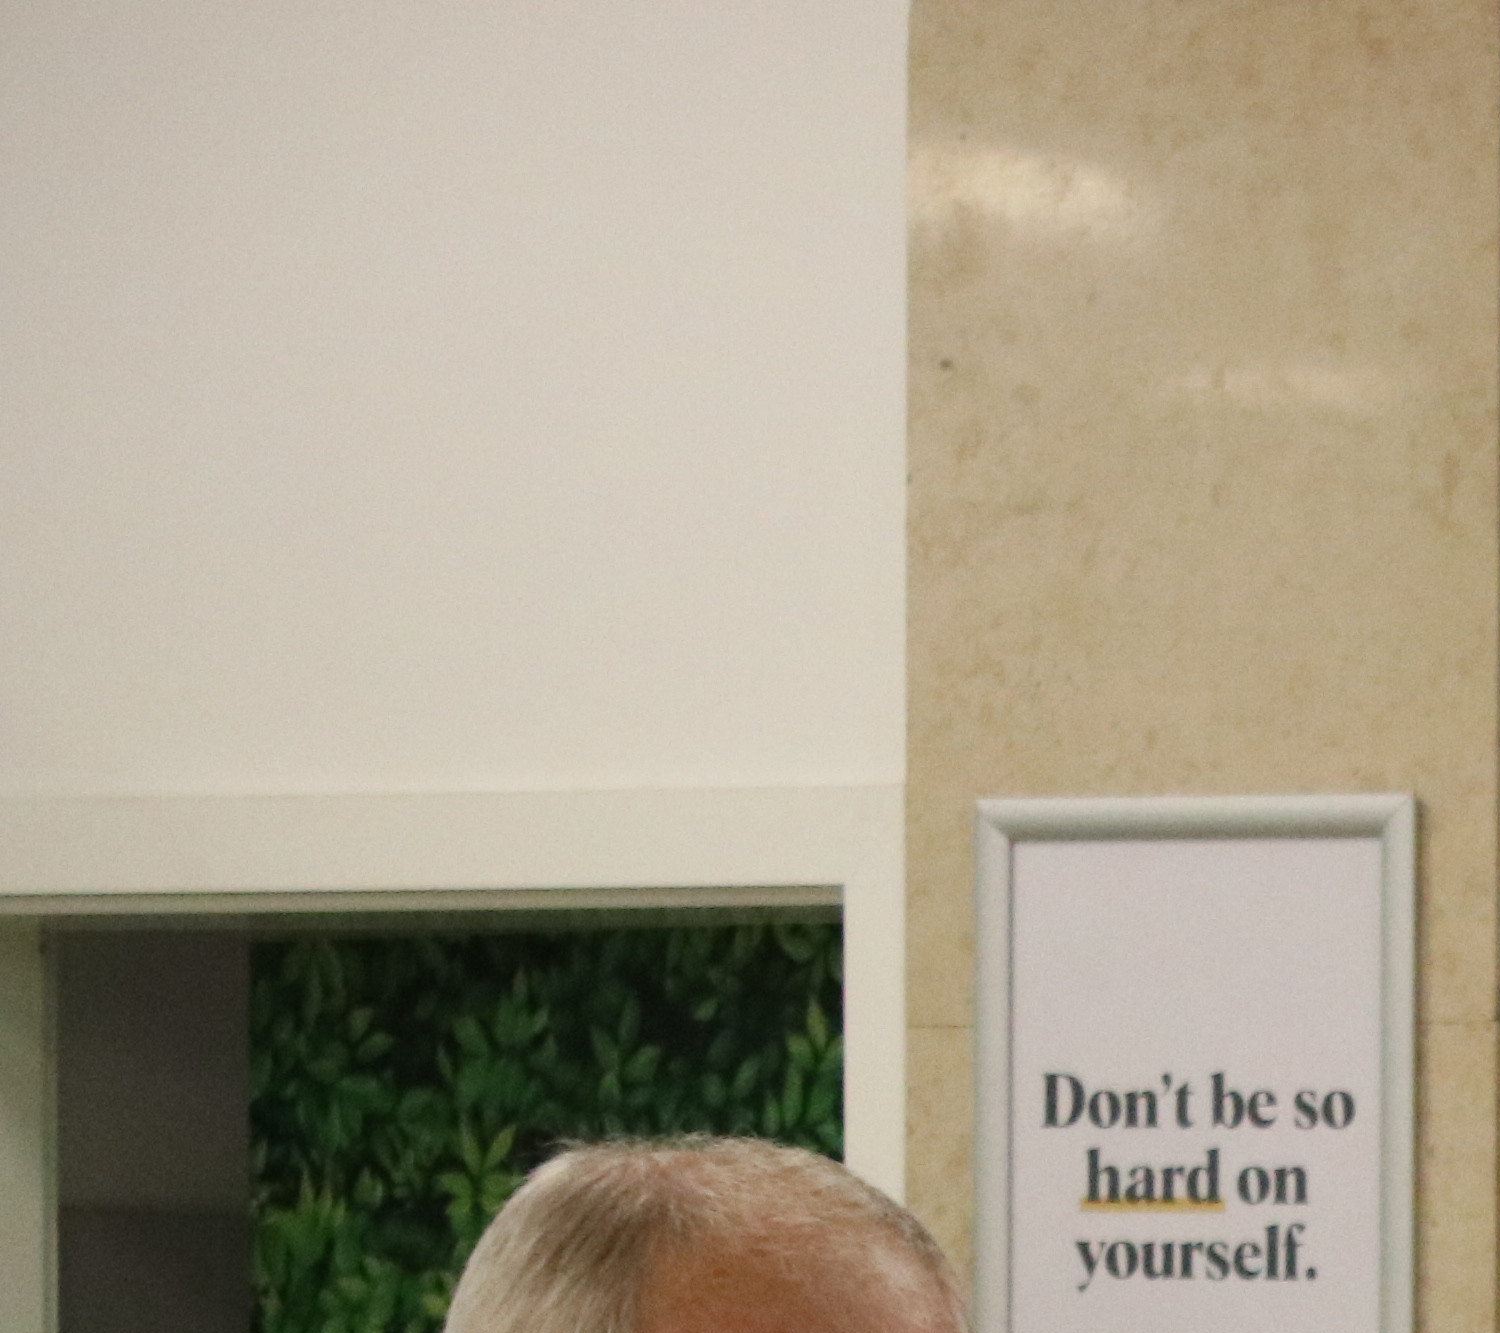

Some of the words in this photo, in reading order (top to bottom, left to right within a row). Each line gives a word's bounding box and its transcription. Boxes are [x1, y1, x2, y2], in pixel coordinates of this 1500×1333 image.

[1042, 1071, 1195, 1130] Don't
[1210, 1072, 1278, 1130] be
[1293, 1088, 1356, 1131] so
[1085, 1146, 1221, 1206] hard
[1236, 1163, 1309, 1206] on
[1074, 1222, 1318, 1293] yourself.
